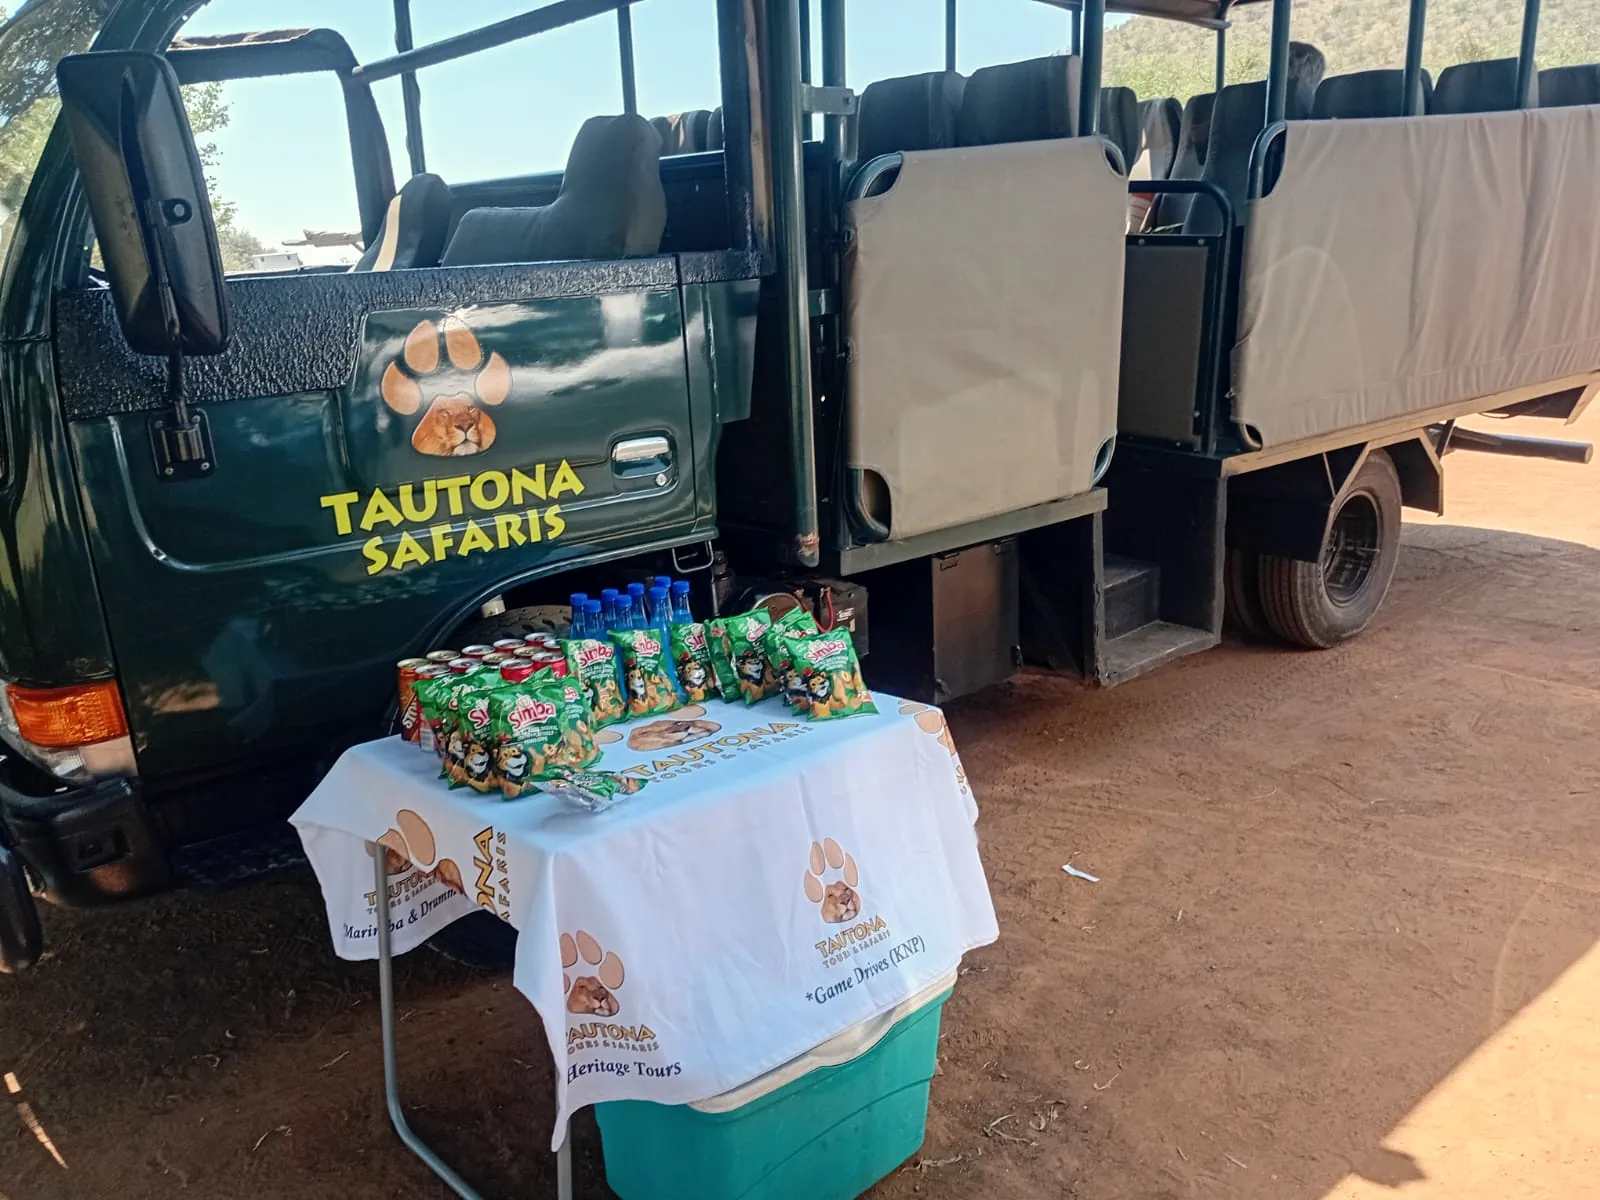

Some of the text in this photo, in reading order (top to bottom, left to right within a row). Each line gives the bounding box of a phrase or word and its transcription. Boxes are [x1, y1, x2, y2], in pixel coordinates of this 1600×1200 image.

[320, 459, 585, 536] TAUTONA
[362, 504, 566, 576] SAFARIS
[805, 640, 847, 661] Simba
[508, 700, 555, 730] Simba
[620, 722, 799, 777] TAUTONA
[496, 832, 510, 920] AFARIS
[408, 909, 418, 924] &
[814, 914, 887, 958] TAUTONA
[853, 958, 890, 984] Drives
[889, 934, 926, 968] (KNP)
[566, 1022, 656, 1045] AUTONA
[568, 1040, 599, 1055] OURS
[567, 1059, 682, 1085] Heritage Tours
